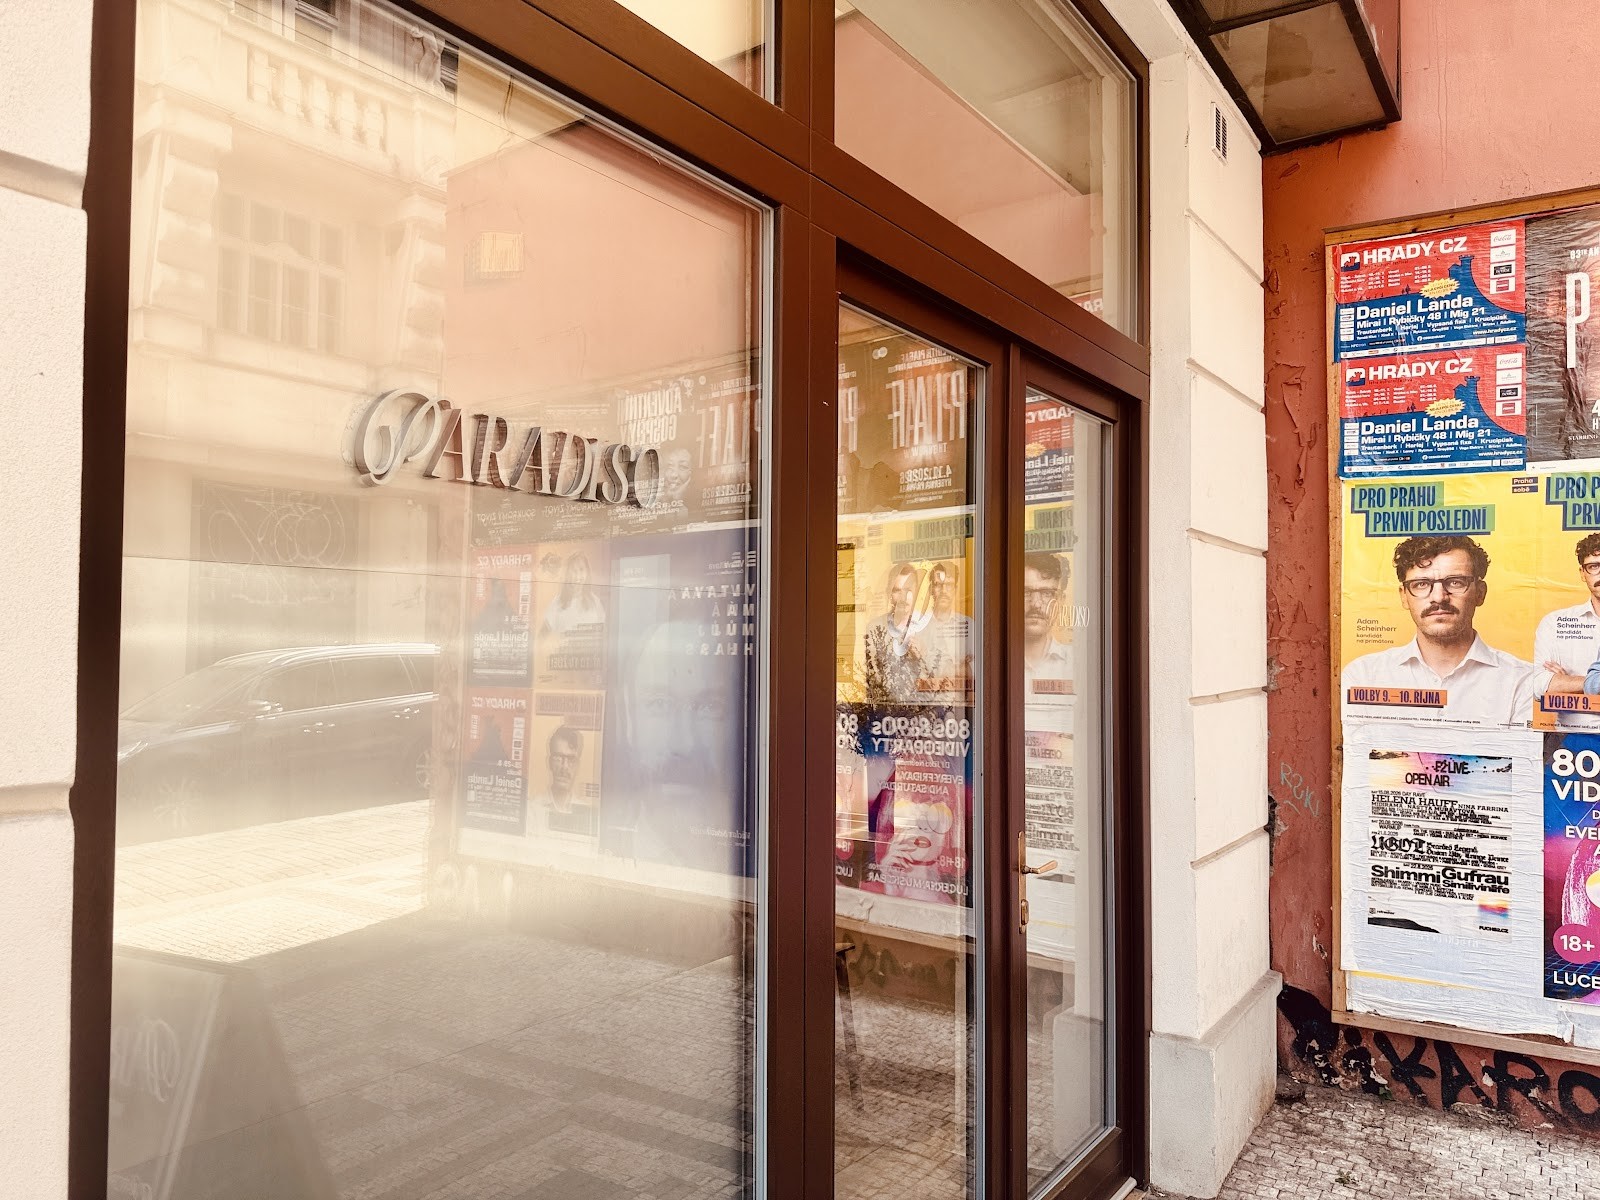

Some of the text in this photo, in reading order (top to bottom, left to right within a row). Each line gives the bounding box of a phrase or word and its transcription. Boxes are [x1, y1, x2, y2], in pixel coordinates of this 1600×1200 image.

[1363, 236, 1468, 265] HRADY CZ
[1356, 294, 1473, 320] Daniel Landa
[1357, 318, 1381, 329] Mirai
[1389, 315, 1425, 326] Rybičky
[1427, 312, 1442, 321] 48
[1450, 309, 1469, 319] Mig
[1471, 307, 1486, 316] 21
[1368, 357, 1473, 381] HRADY CZ
[1361, 415, 1479, 435] Daniel Landa
[1361, 428, 1491, 444] Mirai Rybičky 48 Mig 21
[354, 388, 663, 509] PARADISO
[1513, 477, 1534, 485] Praha
[1555, 476, 1587, 499] PRO
[1358, 485, 1436, 509] PRO PRAHU
[1373, 506, 1487, 532] PRVNÍ POSLEDNÍ
[1046, 598, 1090, 628] PARADISO
[1353, 688, 1380, 701] VOLBY
[1413, 689, 1441, 705] ŘÍJNA
[1548, 694, 1580, 709] VOLBY
[1448, 761, 1469, 775] LIVE
[1551, 748, 1600, 778] 80
[1405, 772, 1450, 787] OPEN AIR
[1371, 794, 1416, 805] HELENA
[1418, 797, 1458, 808] HAUFF
[1551, 779, 1600, 803] VID
[1565, 826, 1600, 840] EVE
[1371, 864, 1509, 885] Shimmi Gufrau
[1559, 934, 1595, 952] 18+
